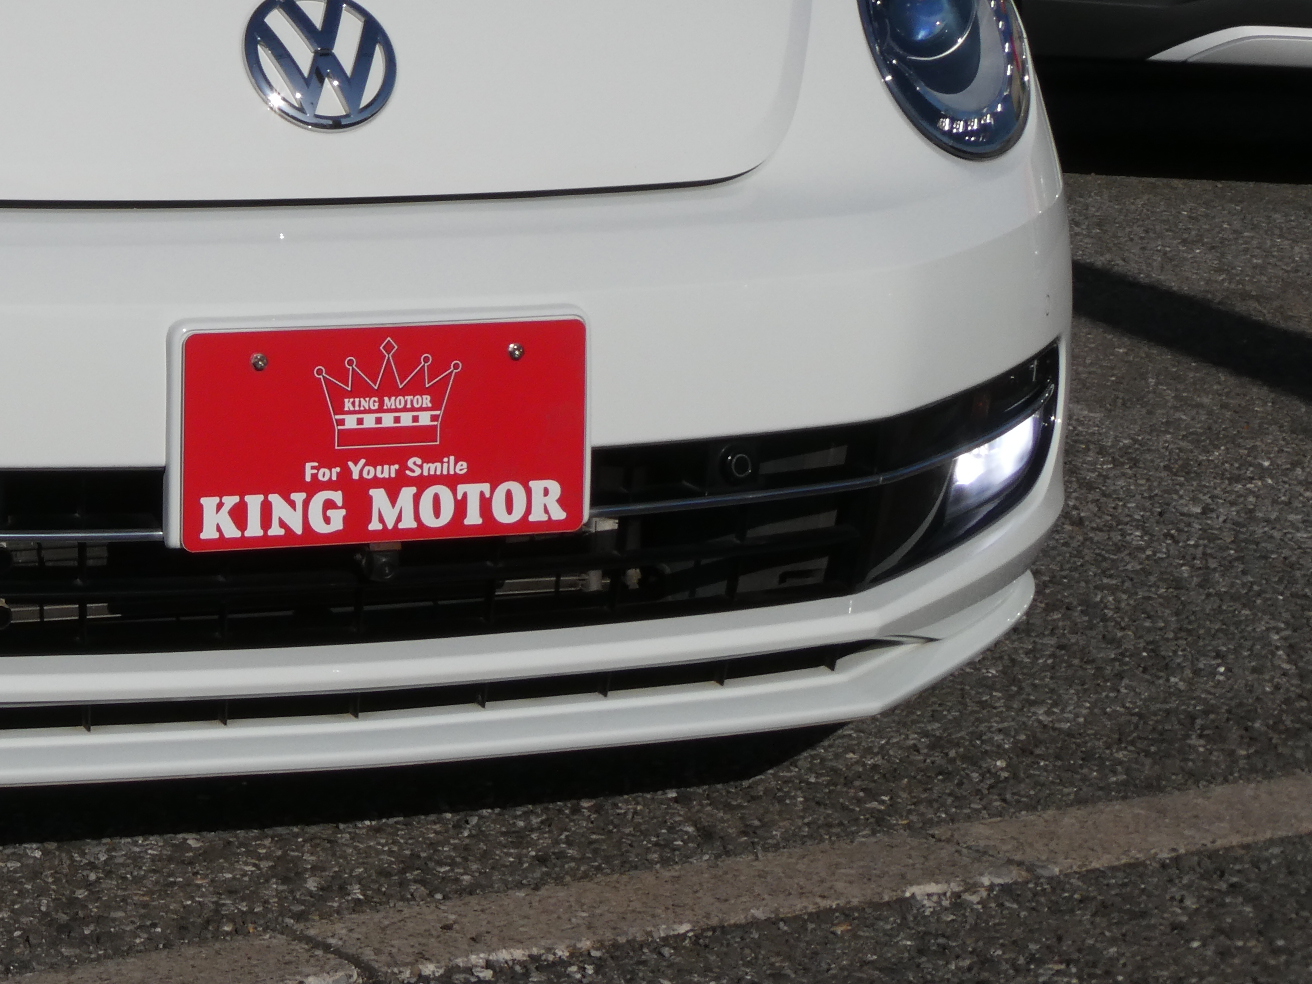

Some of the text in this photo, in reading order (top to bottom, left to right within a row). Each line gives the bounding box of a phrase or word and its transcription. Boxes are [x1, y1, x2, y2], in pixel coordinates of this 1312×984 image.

[344, 395, 433, 411] KING MOTOR
[304, 456, 468, 483] For Your Smile
[199, 479, 568, 540] KING MOTOR
